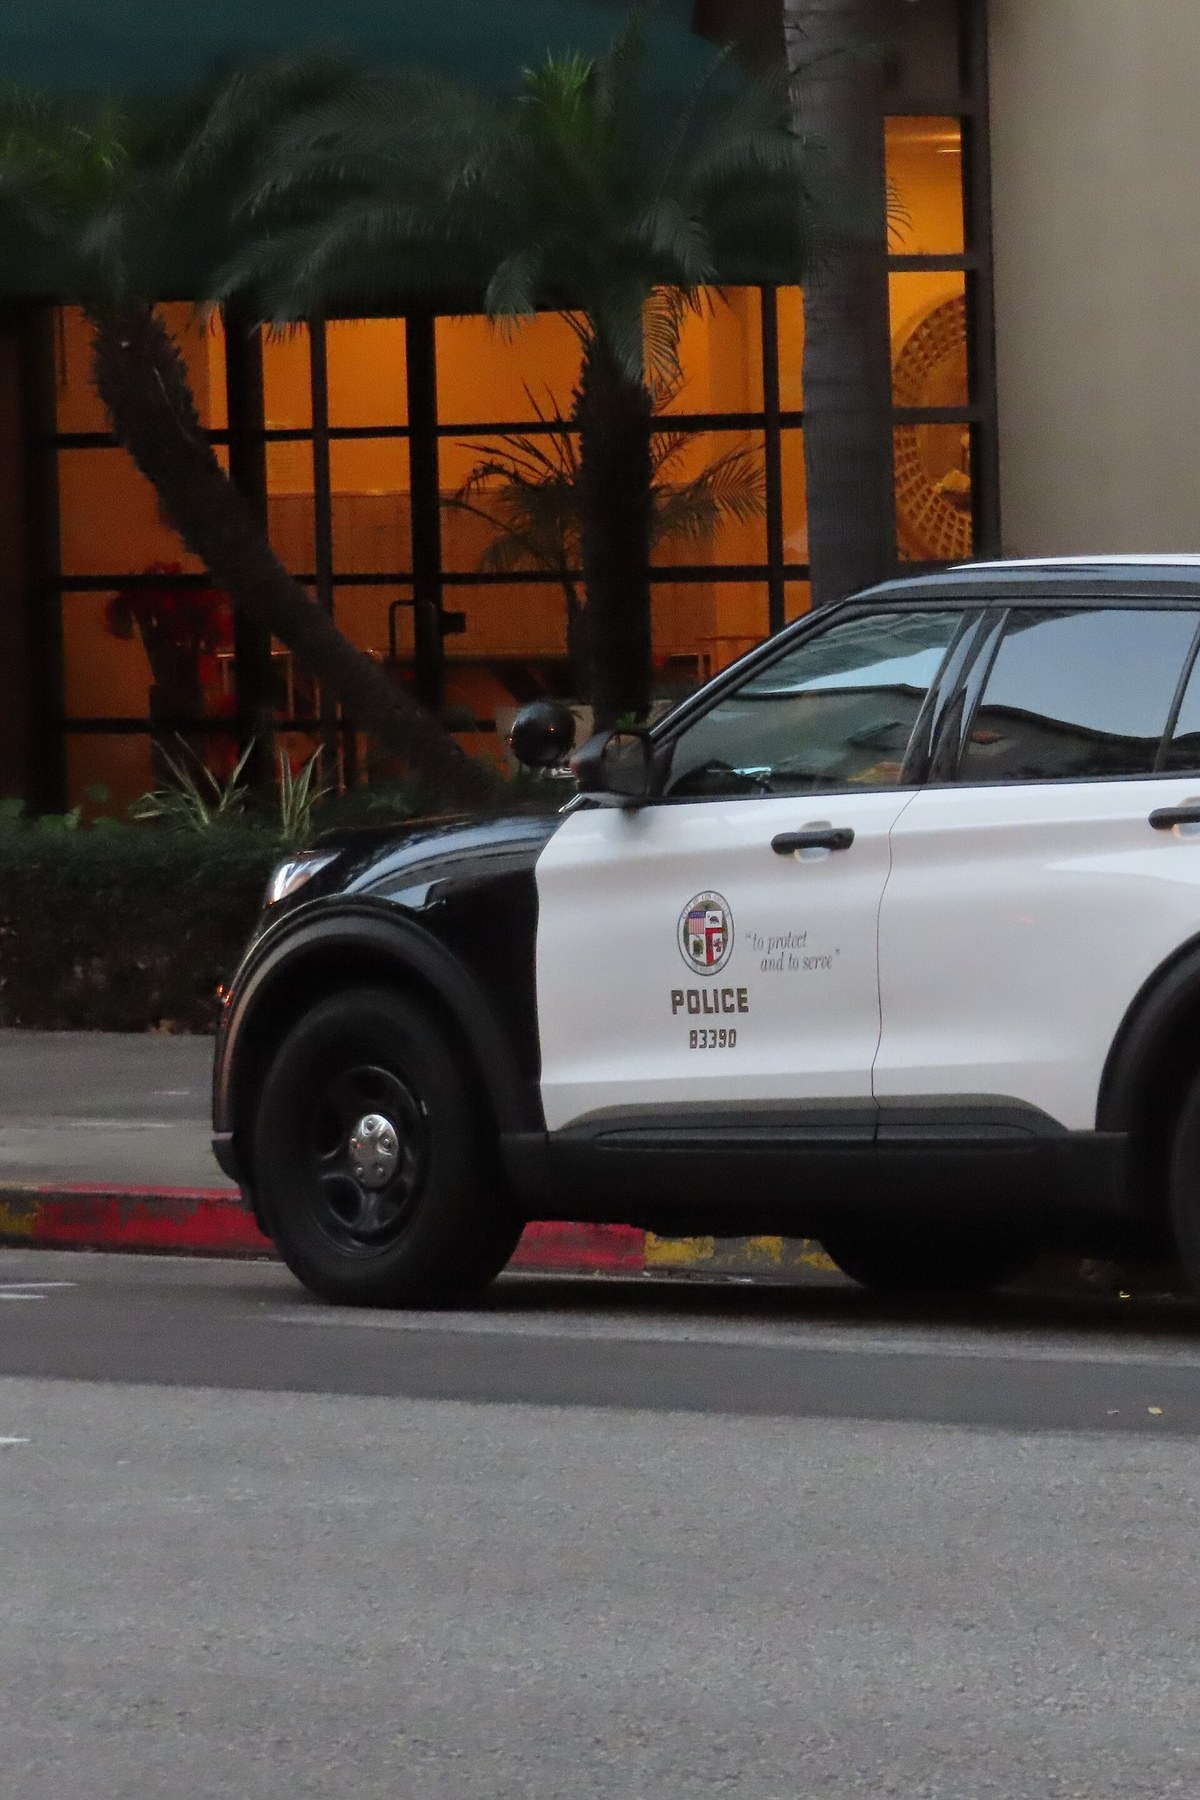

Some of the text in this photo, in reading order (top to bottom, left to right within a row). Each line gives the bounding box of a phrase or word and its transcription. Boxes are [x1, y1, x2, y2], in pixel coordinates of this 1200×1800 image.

[767, 930, 807, 954] protect
[760, 951, 784, 973] and
[788, 952, 800, 971] to
[671, 987, 749, 1015] POLICE
[689, 1028, 737, 1049] 83390
